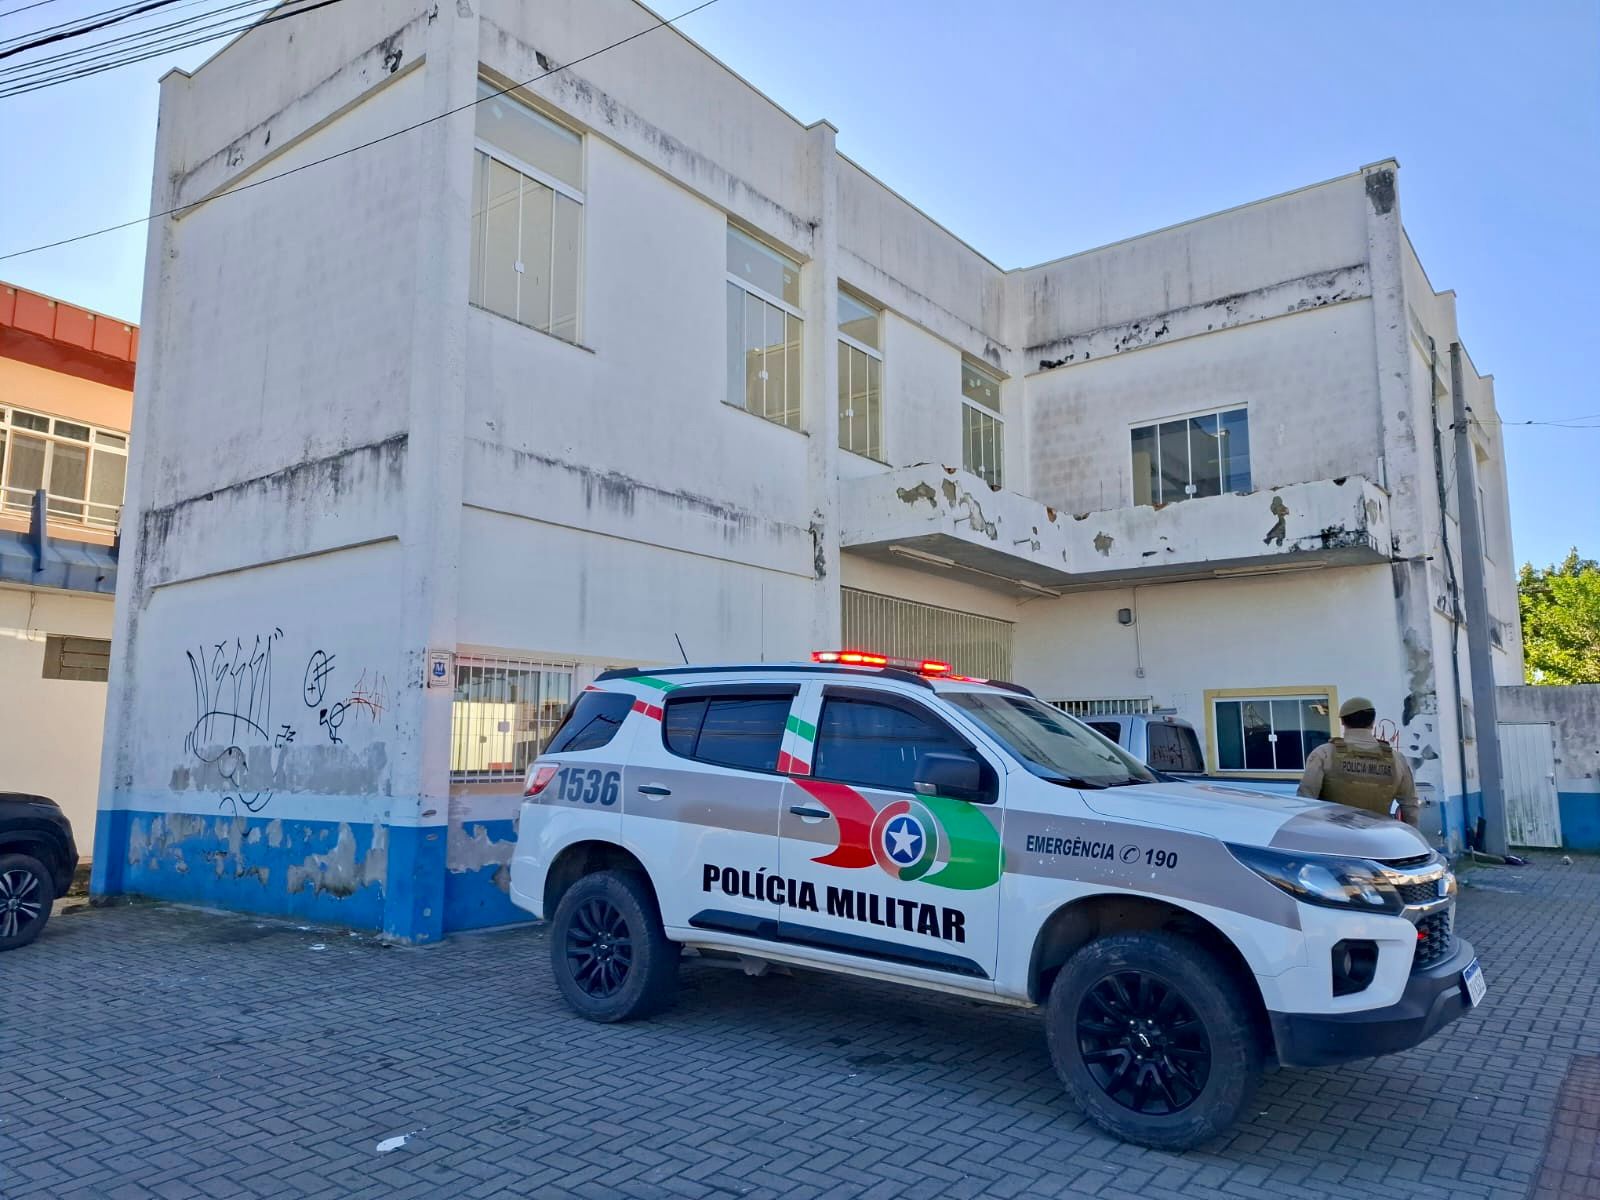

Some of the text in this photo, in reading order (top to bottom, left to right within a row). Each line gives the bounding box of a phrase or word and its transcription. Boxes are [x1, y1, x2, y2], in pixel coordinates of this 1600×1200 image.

[558, 767, 620, 806] 1536
[1367, 760, 1393, 777] MILITAR
[1026, 834, 1178, 869] EMERGÊNCIA 190
[702, 863, 966, 944] POLÍCIA MILITAR
